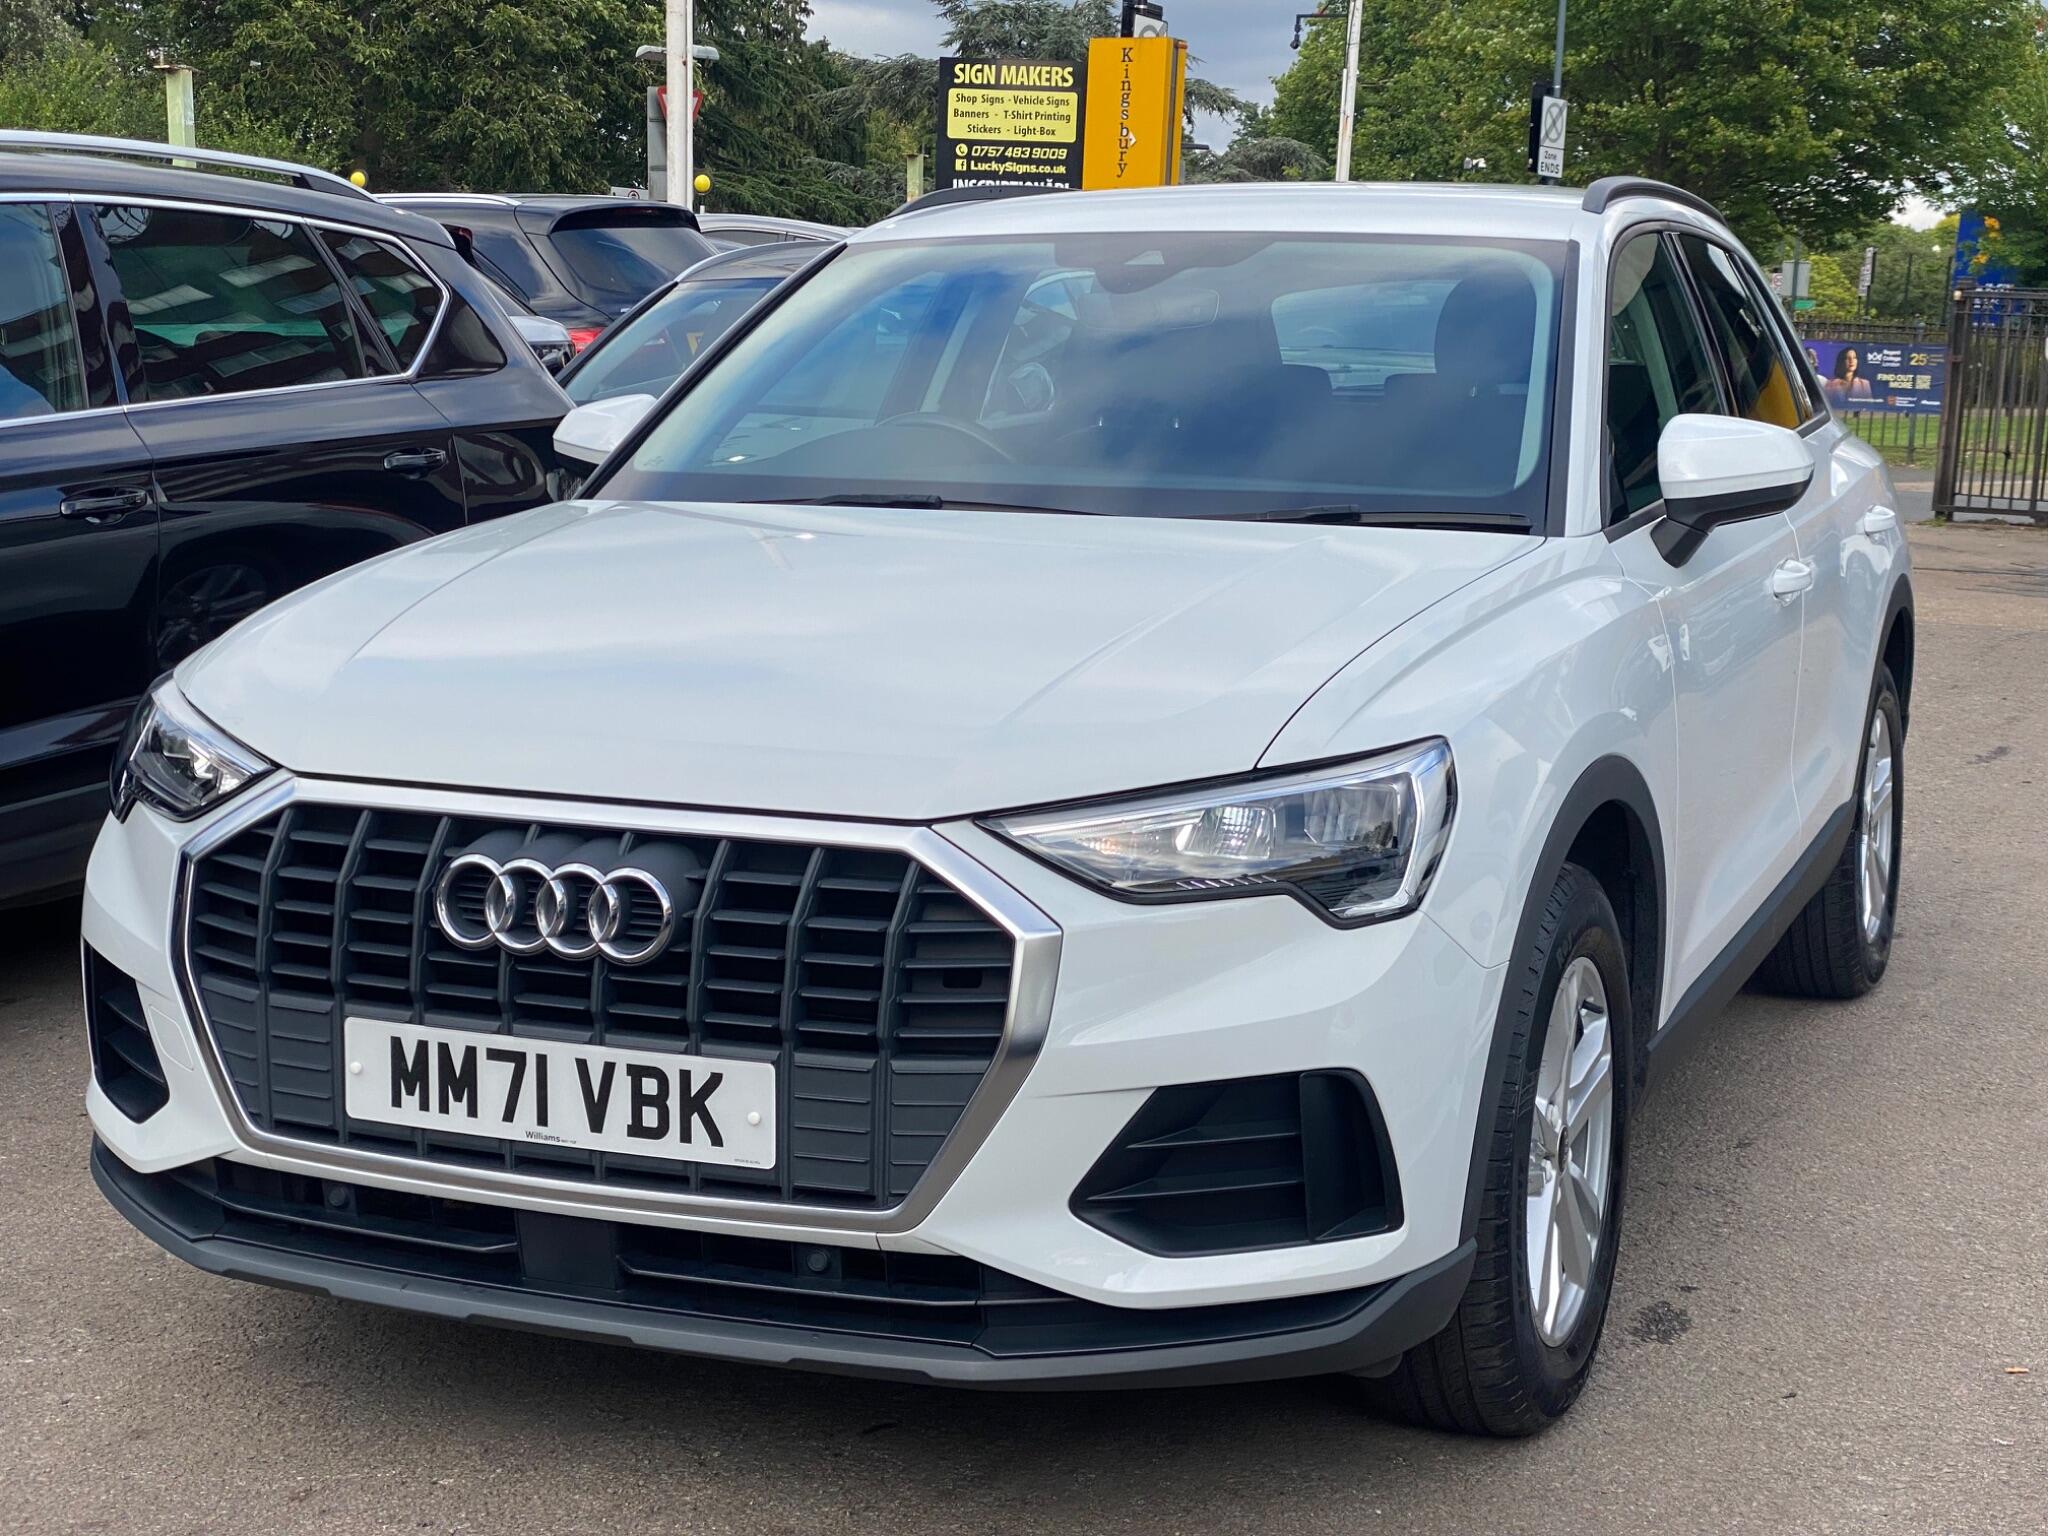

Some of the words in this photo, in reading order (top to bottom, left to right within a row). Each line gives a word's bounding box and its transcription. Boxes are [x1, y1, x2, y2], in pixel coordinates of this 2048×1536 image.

[953, 63, 996, 85] SIGN
[1000, 65, 1074, 87] MAKERS
[955, 93, 977, 105] Shop
[981, 94, 1004, 105] Signs
[1013, 95, 1044, 105] Vehicle
[1046, 96, 1070, 108] Signs
[953, 108, 989, 118] Banners
[1004, 110, 1032, 120] T-Shirt
[1034, 111, 1071, 123] Printing
[1116, 47, 1133, 177] Kingsbury
[967, 124, 1001, 134] Stickers
[1013, 125, 1056, 137] Light-Box
[971, 145, 1004, 157] 0757
[1004, 147, 1030, 158] 483
[1031, 148, 1068, 160] 9009
[1544, 150, 1557, 160] Zone
[970, 160, 1067, 175] LuckySigns.co.uk
[1540, 162, 1560, 174] ENDS
[1909, 353, 1927, 366] 25
[1877, 373, 1896, 381] FIND
[1897, 374, 1914, 382] OUT
[1888, 381, 1914, 389] MORE
[390, 1035, 548, 1128] MM71
[574, 1057, 725, 1148] VBK
[525, 1130, 560, 1142] Williams
